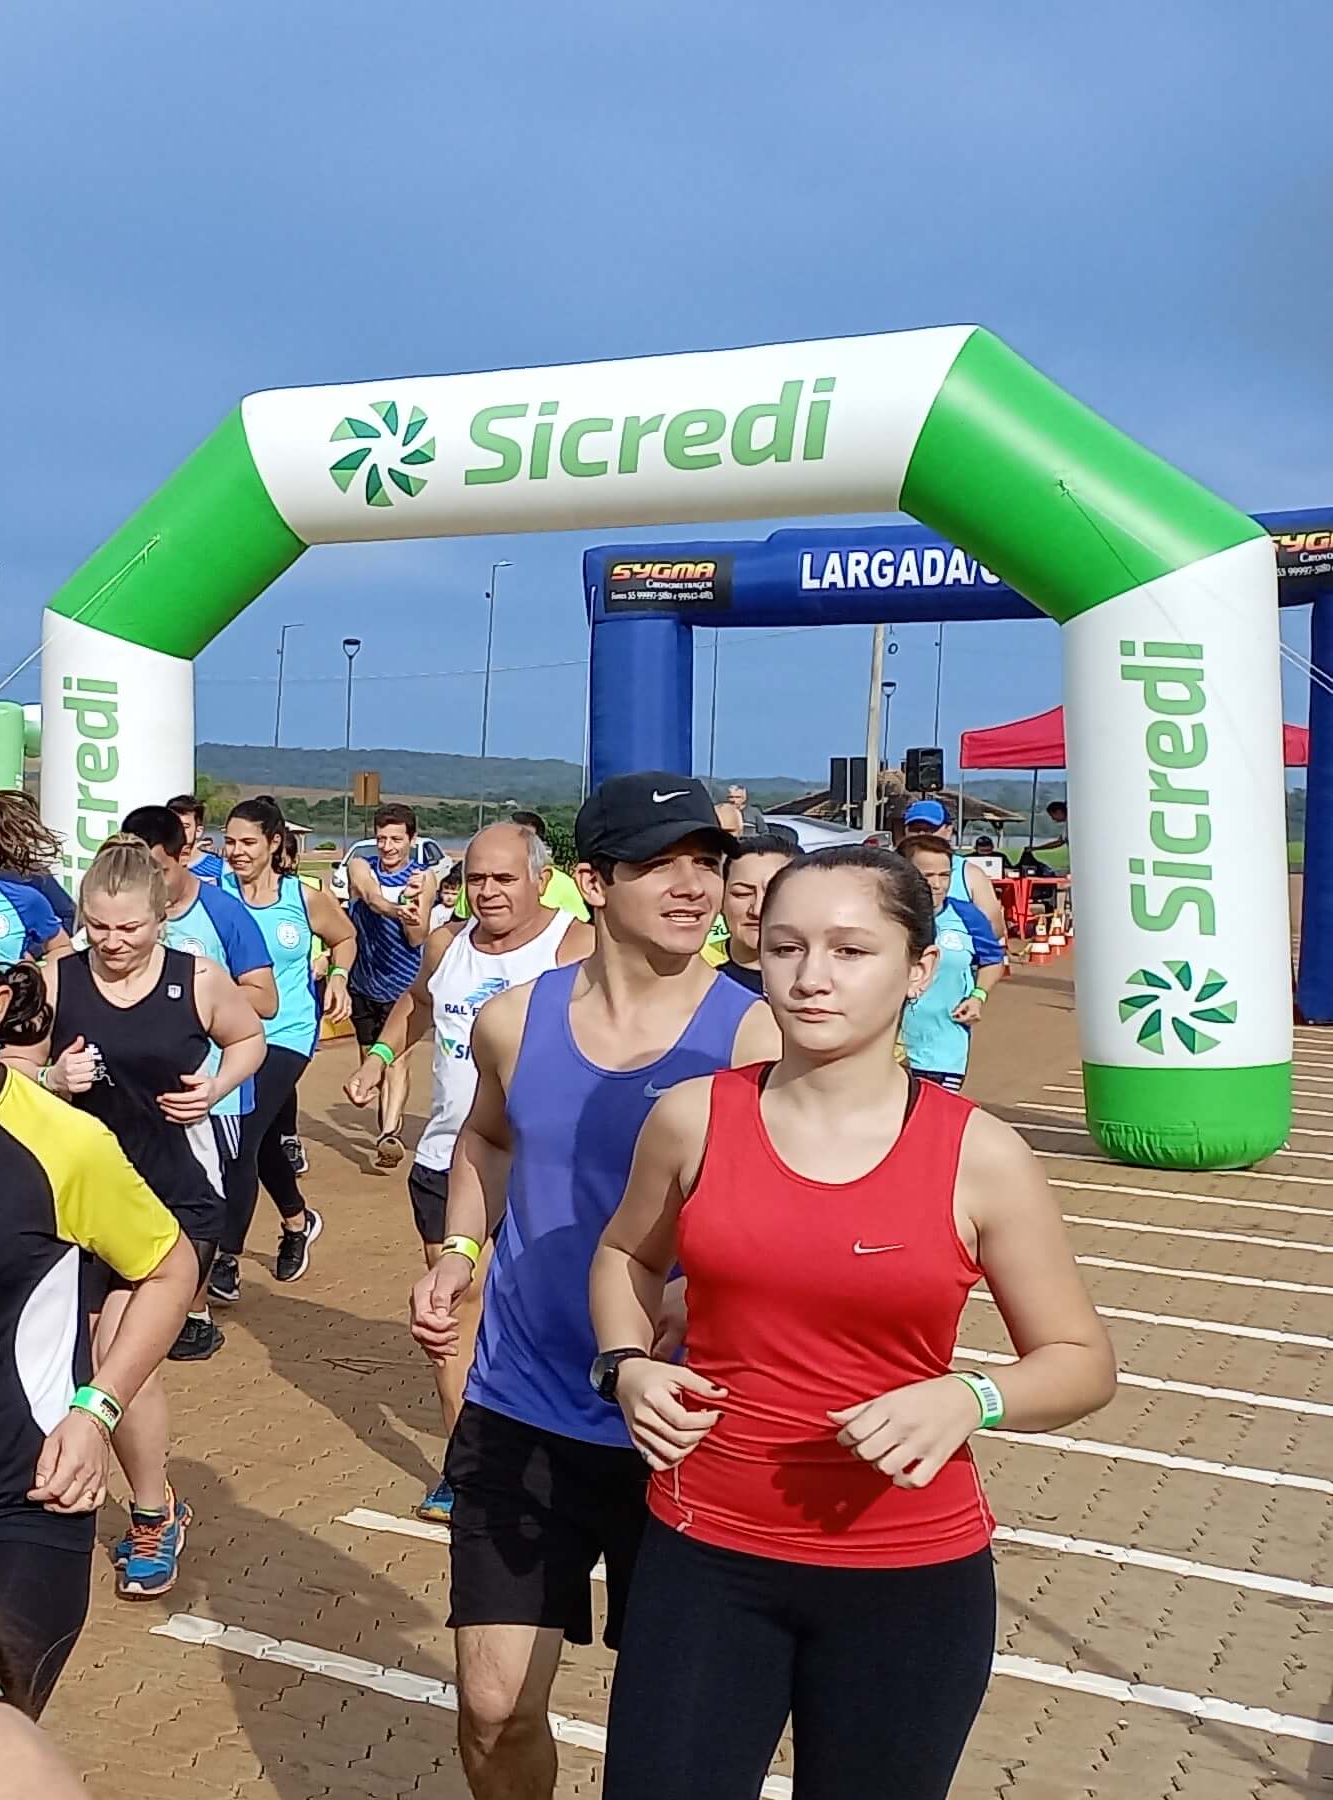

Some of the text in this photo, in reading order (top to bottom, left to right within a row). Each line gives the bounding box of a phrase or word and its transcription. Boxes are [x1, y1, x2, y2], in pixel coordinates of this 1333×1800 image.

[464, 376, 837, 486] Sicredi
[611, 562, 716, 580] SYGMA
[1120, 639, 1216, 936] Sicredi
